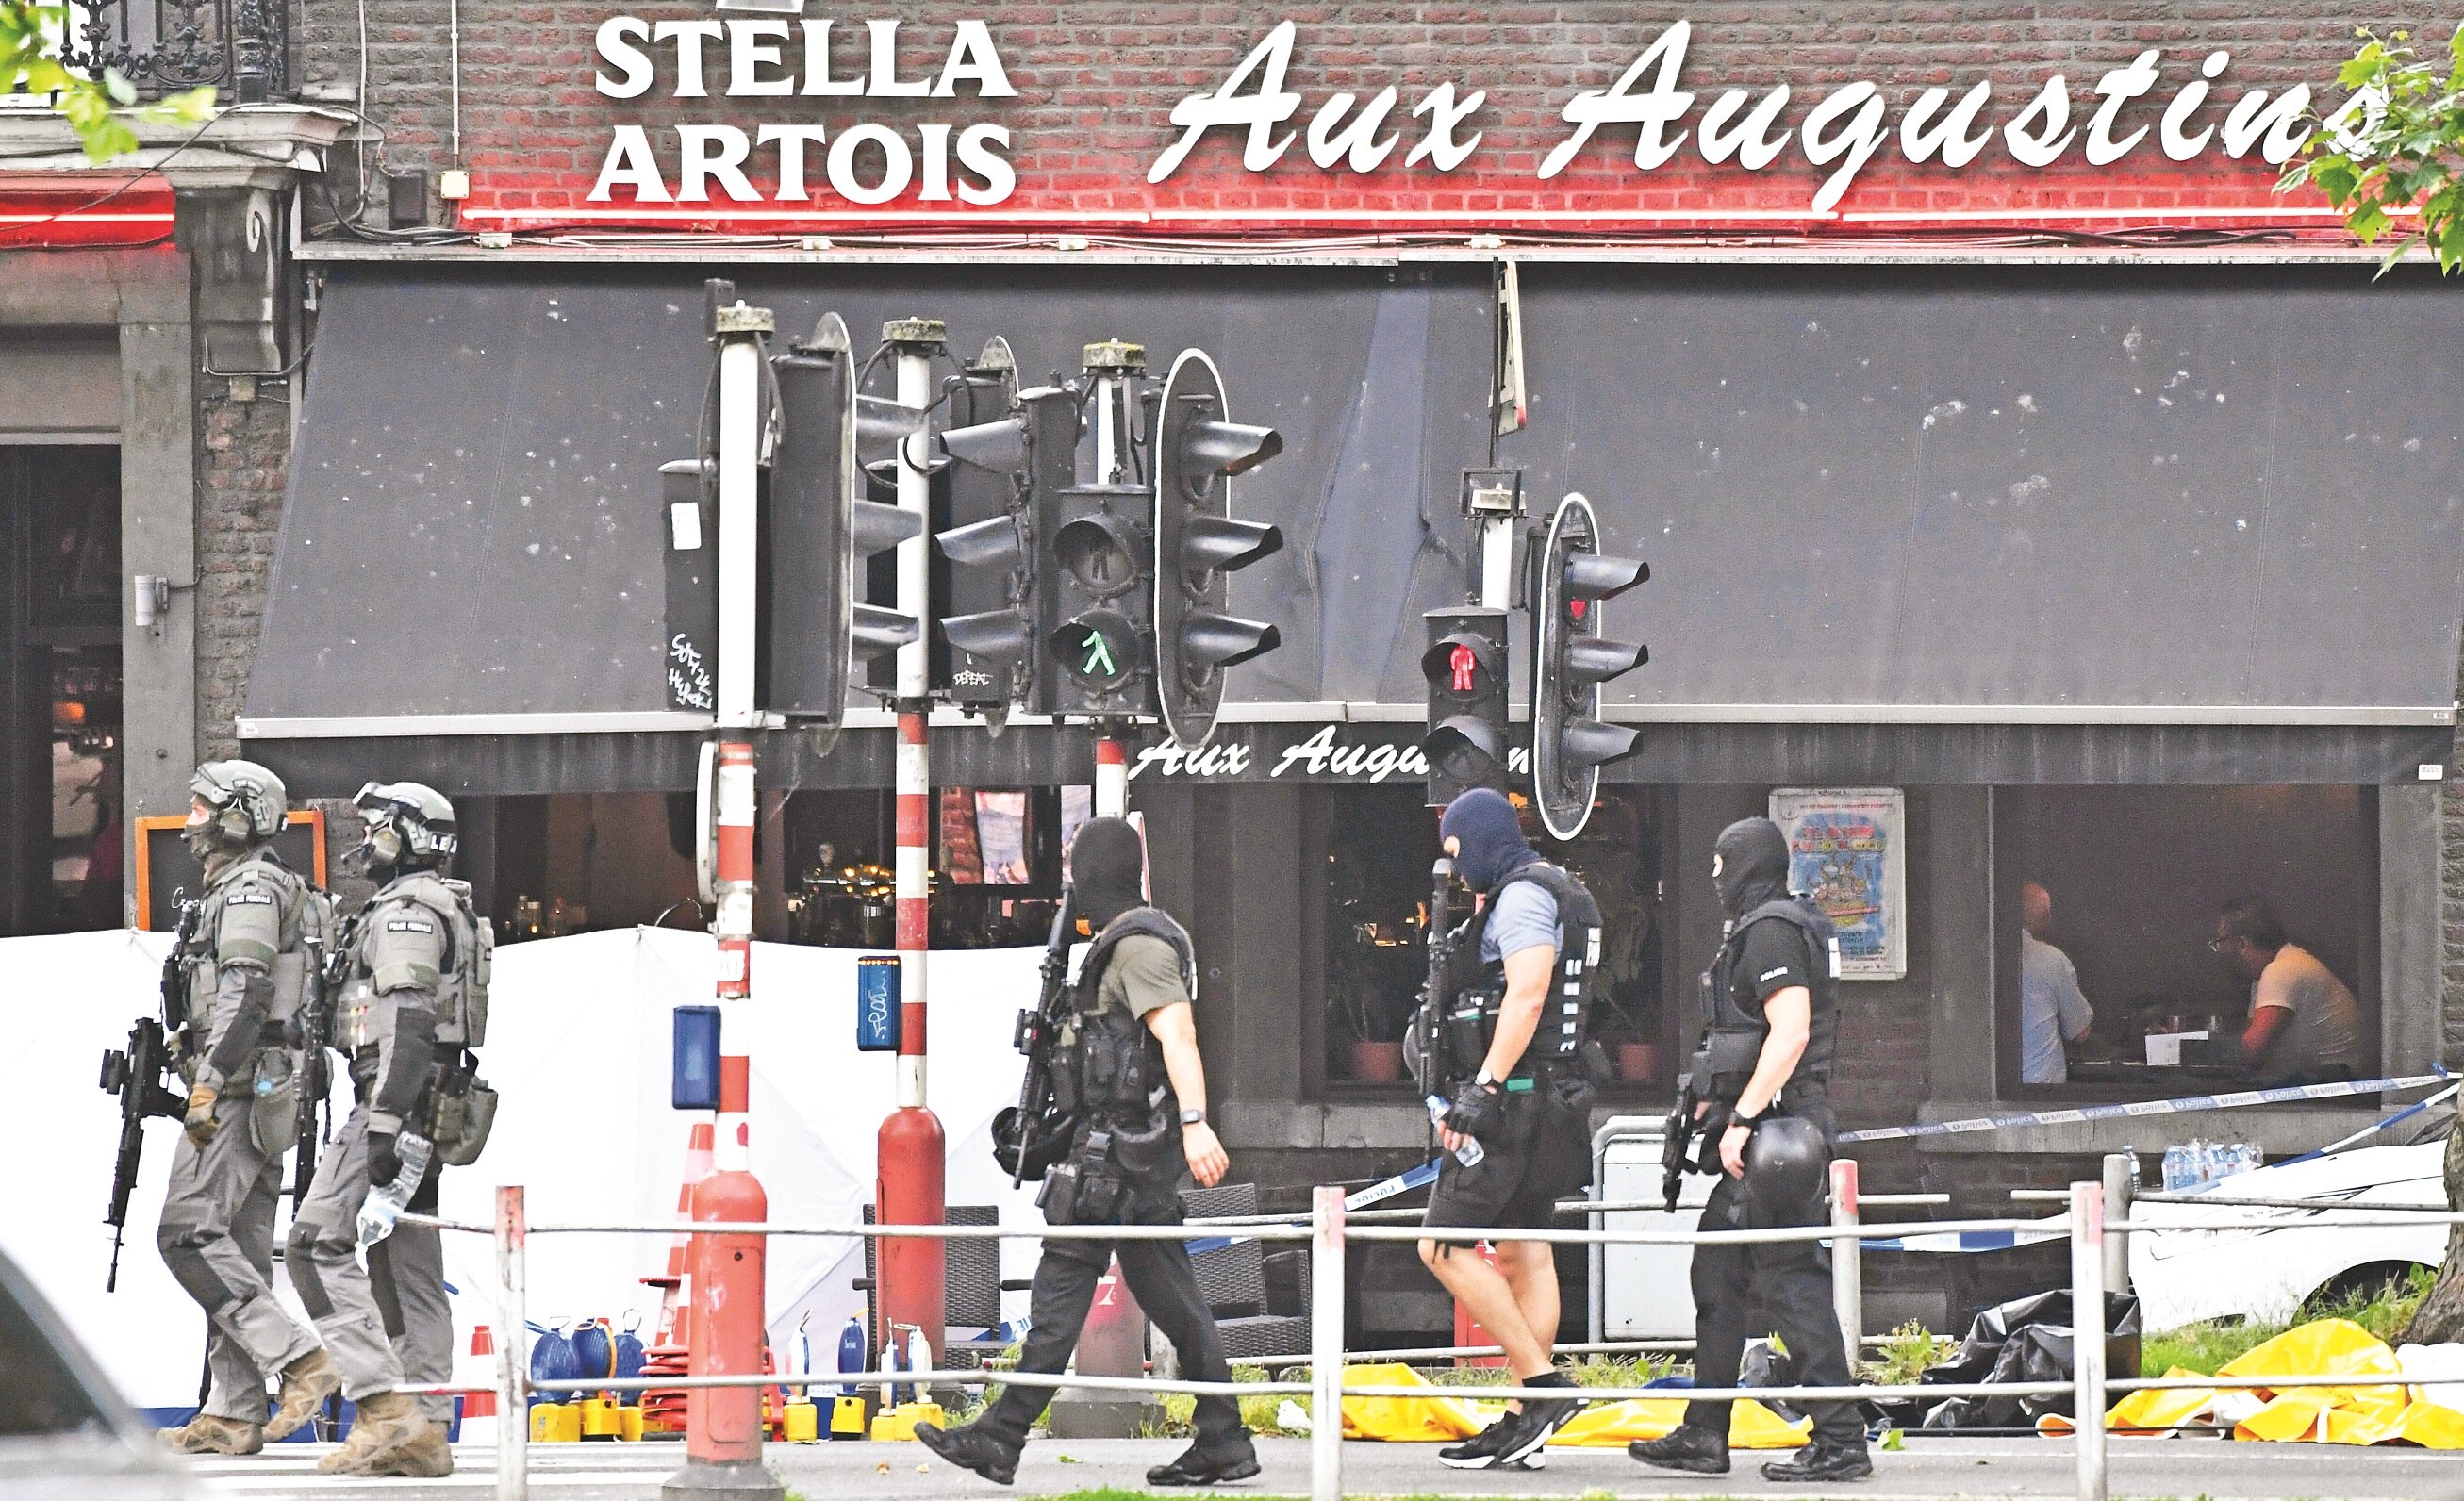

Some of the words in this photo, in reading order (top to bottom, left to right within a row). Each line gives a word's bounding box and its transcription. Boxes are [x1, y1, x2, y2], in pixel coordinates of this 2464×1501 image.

[596, 17, 1018, 98] STELLA
[1147, 19, 1486, 184] Aux
[1537, 19, 2392, 213] Augustins
[586, 124, 1016, 206] ARTOIS
[1128, 735, 1250, 781] Aux
